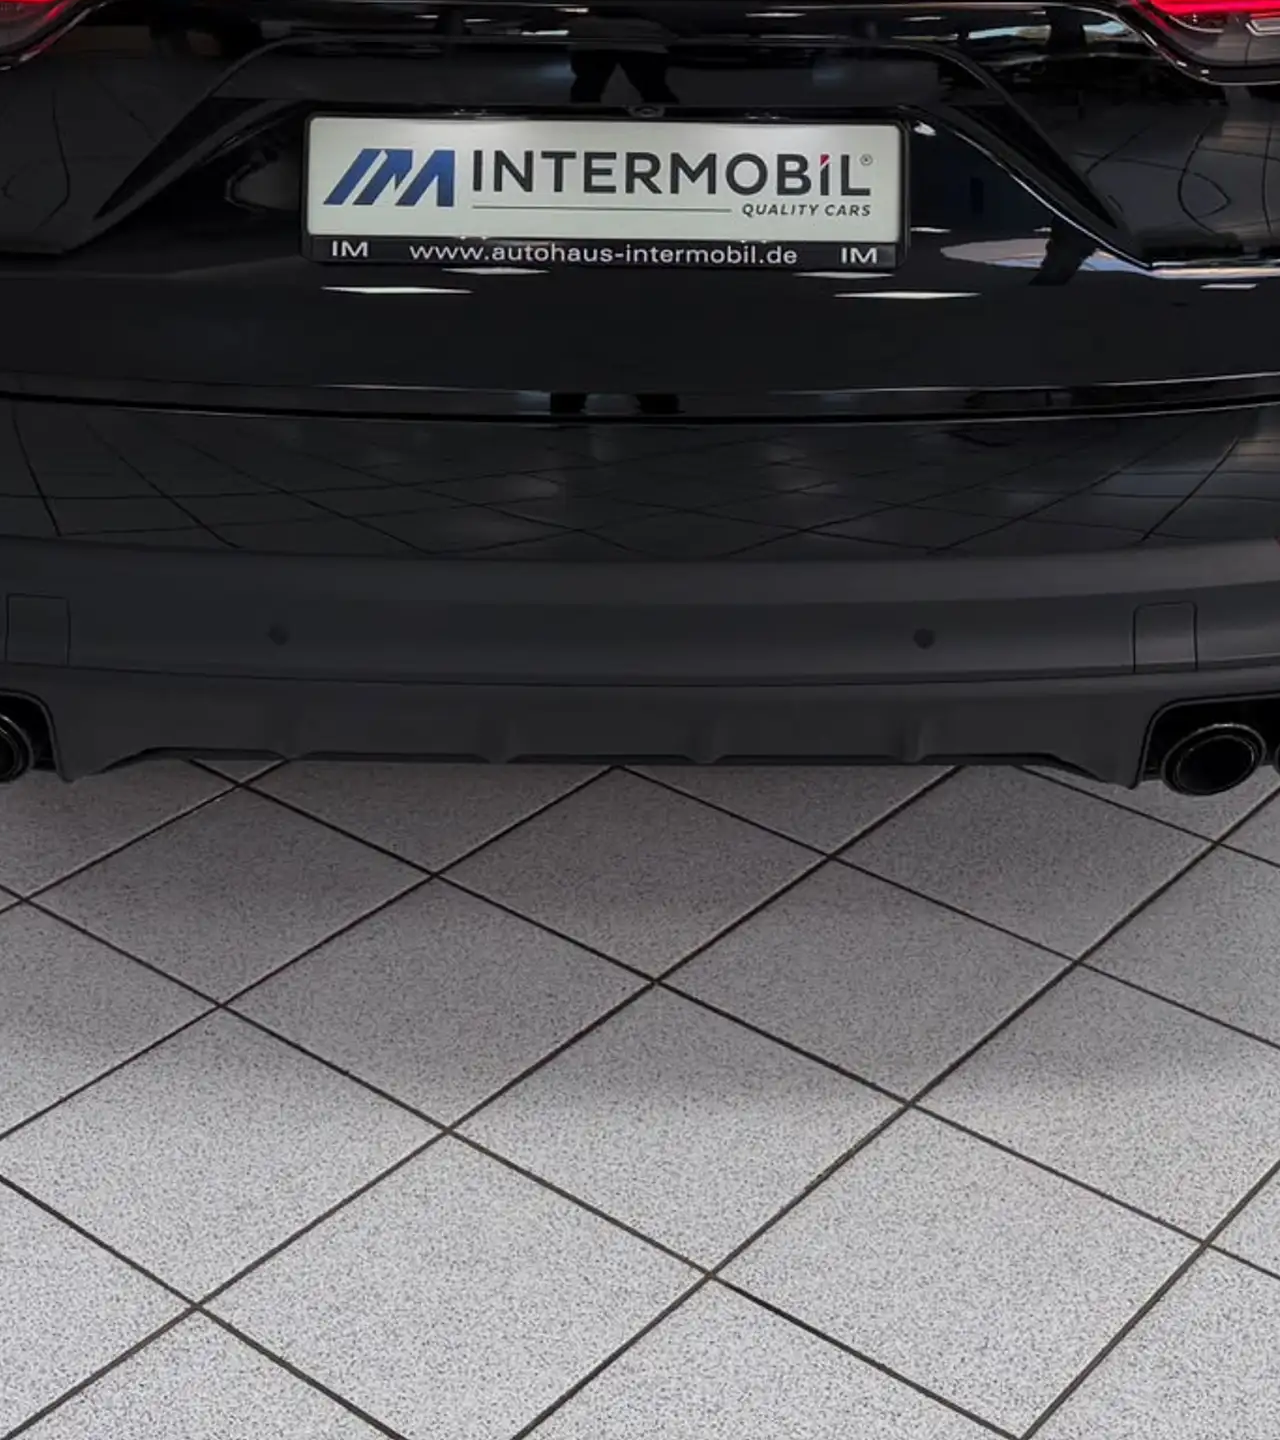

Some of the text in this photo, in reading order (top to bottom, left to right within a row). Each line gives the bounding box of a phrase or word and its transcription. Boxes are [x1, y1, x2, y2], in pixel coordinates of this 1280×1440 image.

[741, 203, 871, 218] QUALITY CARS
[331, 240, 878, 265] IM www.autohaus-intermobil.de IM
